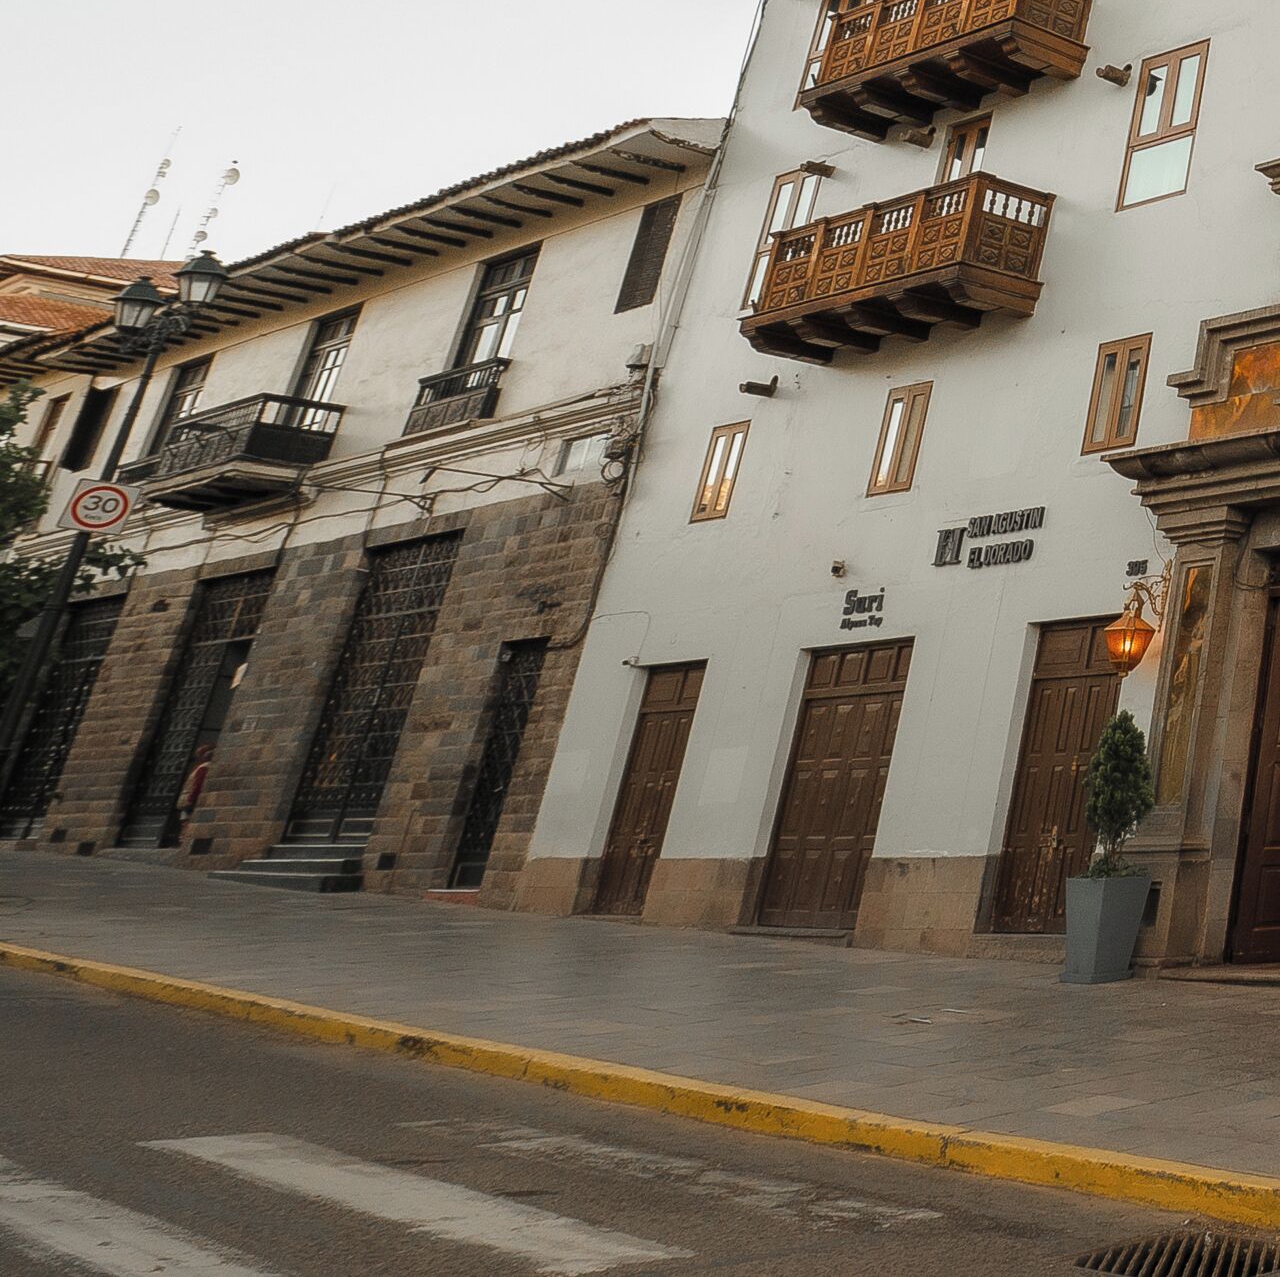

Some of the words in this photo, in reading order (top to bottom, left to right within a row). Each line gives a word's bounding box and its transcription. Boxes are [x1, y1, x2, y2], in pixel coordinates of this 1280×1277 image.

[82, 495, 120, 514] 30
[967, 514, 994, 539] SAN
[991, 506, 1046, 535] AGUSTIN
[967, 546, 983, 569] EL
[983, 539, 1035, 566] DORADO
[842, 586, 885, 615] Suri
